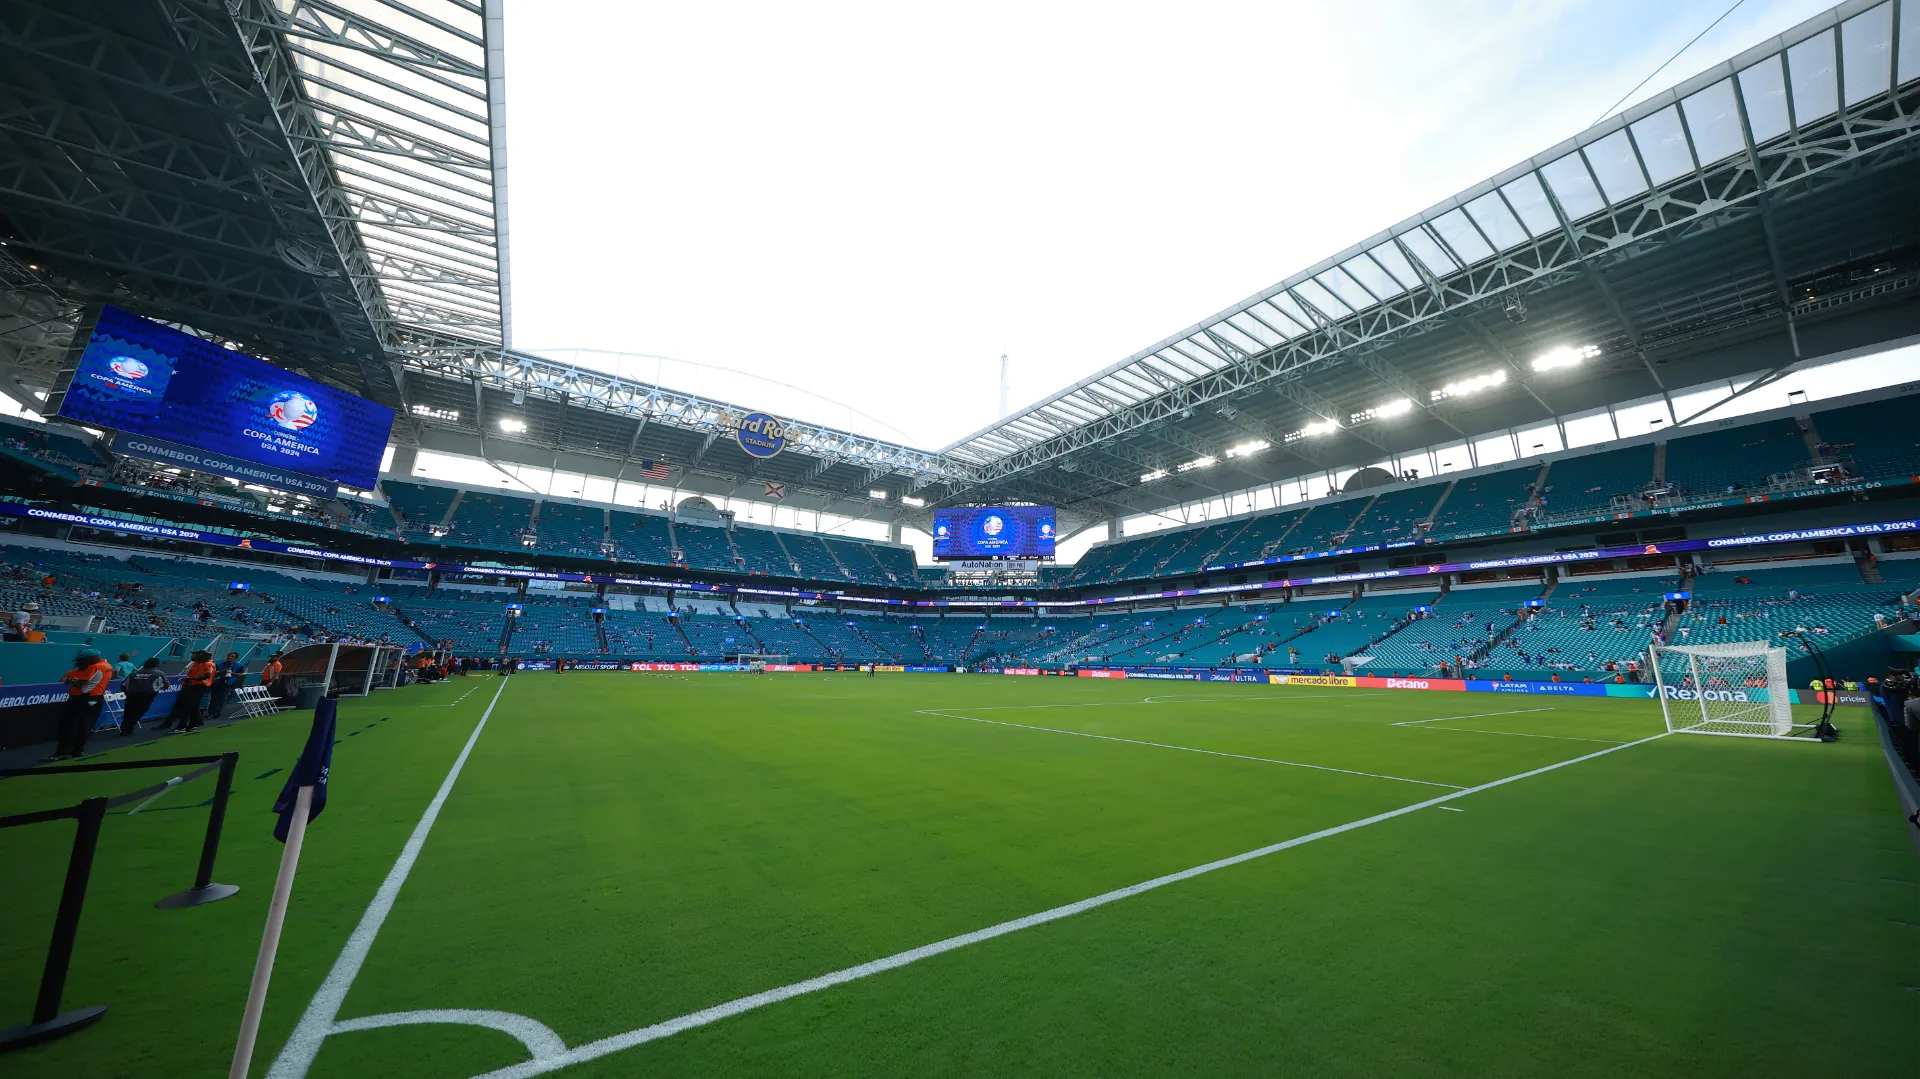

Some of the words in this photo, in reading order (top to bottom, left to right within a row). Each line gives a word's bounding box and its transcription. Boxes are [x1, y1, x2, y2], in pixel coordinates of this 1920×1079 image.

[90, 373, 114, 384] COPA
[115, 380, 152, 395] AMERICA
[762, 419, 801, 446] Rock
[243, 428, 272, 443] COPA
[274, 437, 320, 455] AMERICA
[745, 438, 776, 450] STADIUM
[261, 442, 277, 452] USA
[280, 447, 300, 458] 2024
[127, 441, 200, 464] CONMEBOL
[202, 458, 234, 472] COPA
[234, 466, 283, 484] AMERICA
[285, 477, 303, 488] USA
[304, 482, 328, 493] 2024
[120, 486, 145, 496] SUPER
[148, 490, 170, 500] BOWL
[1793, 489, 1826, 498] LARRY
[1830, 484, 1862, 493] LITTLE
[27, 508, 88, 523] CONMEBOL
[90, 518, 117, 528] COPA
[117, 522, 159, 534] AMERICA
[161, 528, 178, 536] USA
[178, 530, 199, 539] 2024
[1708, 536, 1768, 548] CONMEBOL
[1768, 532, 1800, 542] COPA
[1800, 527, 1855, 539] AMERICA
[1856, 524, 1882, 533] USA
[1883, 522, 1916, 531] 2024
[287, 546, 322, 557] CONMEBOL
[323, 552, 339, 560] COPA
[339, 554, 364, 563] AMERICA
[1470, 560, 1508, 569] CONMEBOL
[1508, 558, 1528, 566] COPA
[1528, 555, 1562, 564] AMERICA
[1579, 551, 1599, 559] 2024
[464, 566, 496, 574] CONMEBOL
[511, 570, 535, 578] AMERICA
[961, 560, 1004, 570] AutoNation
[1312, 575, 1338, 584] CONMEBOL
[1352, 572, 1374, 580] AMERICA
[1092, 670, 1111, 678] Betano
[1290, 676, 1328, 685] mercado
[1328, 676, 1348, 686] libre
[1386, 678, 1429, 689] Betano
[26, 694, 50, 706] COPA
[1663, 685, 1748, 702] Rexona
